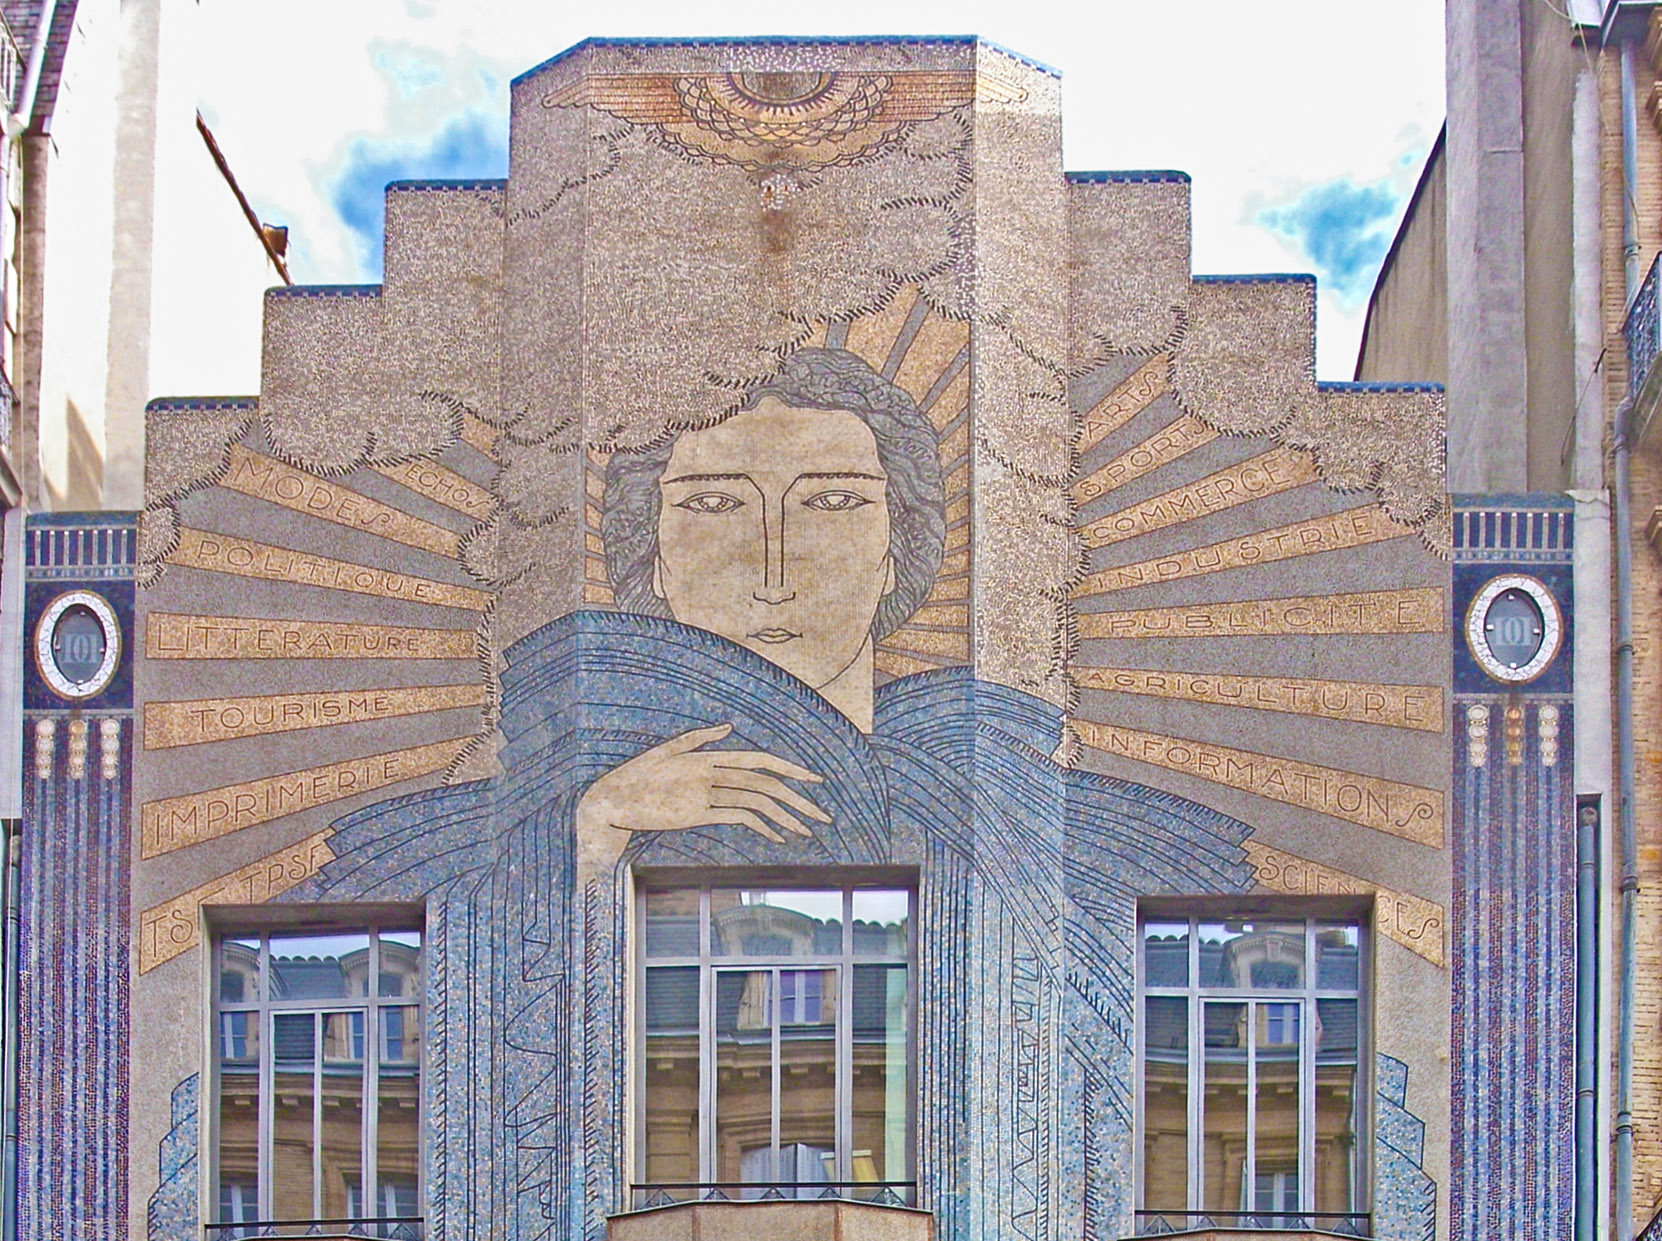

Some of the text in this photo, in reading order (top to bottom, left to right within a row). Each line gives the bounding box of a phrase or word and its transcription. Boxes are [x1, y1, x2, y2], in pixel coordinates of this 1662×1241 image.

[1087, 371, 1159, 440] ARTS
[404, 462, 490, 508] ECHOS
[1079, 414, 1206, 497] SPORTS
[233, 457, 392, 526] MODES
[1092, 456, 1292, 541] COMMERCE
[197, 539, 431, 598] POLITIQUE
[1097, 515, 1373, 589] INDUSTRIE
[157, 623, 420, 652] LITTERATURE
[1110, 599, 1422, 634] PUBLICITE
[190, 696, 390, 733] TOURISME
[1087, 671, 1427, 723] AGRICULTURE
[156, 758, 400, 847] IMPRIMERIE
[1091, 729, 1435, 828] INFORMATIONS
